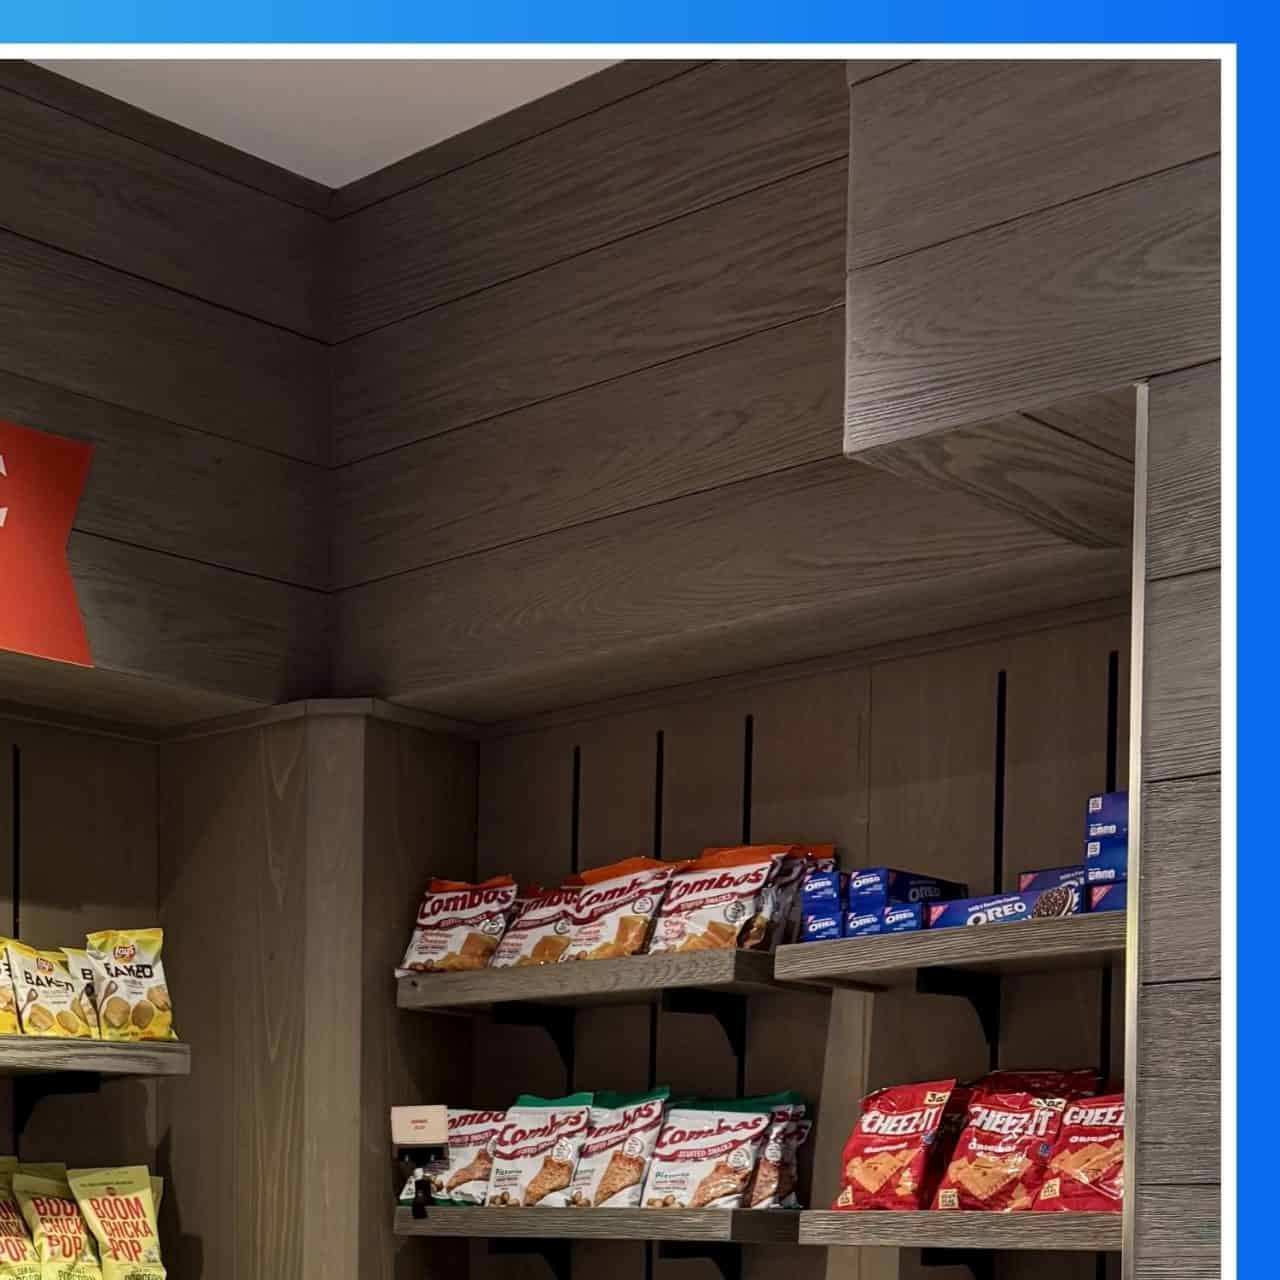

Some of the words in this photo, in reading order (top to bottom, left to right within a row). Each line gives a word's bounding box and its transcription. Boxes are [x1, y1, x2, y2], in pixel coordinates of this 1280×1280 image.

[666, 866, 768, 902] Combos
[967, 901, 1027, 926] OREO
[655, 1116, 763, 1148] Combos
[89, 1196, 147, 1220] BOOM
[100, 1220, 154, 1239] CHICKA
[108, 1239, 143, 1263] POP
